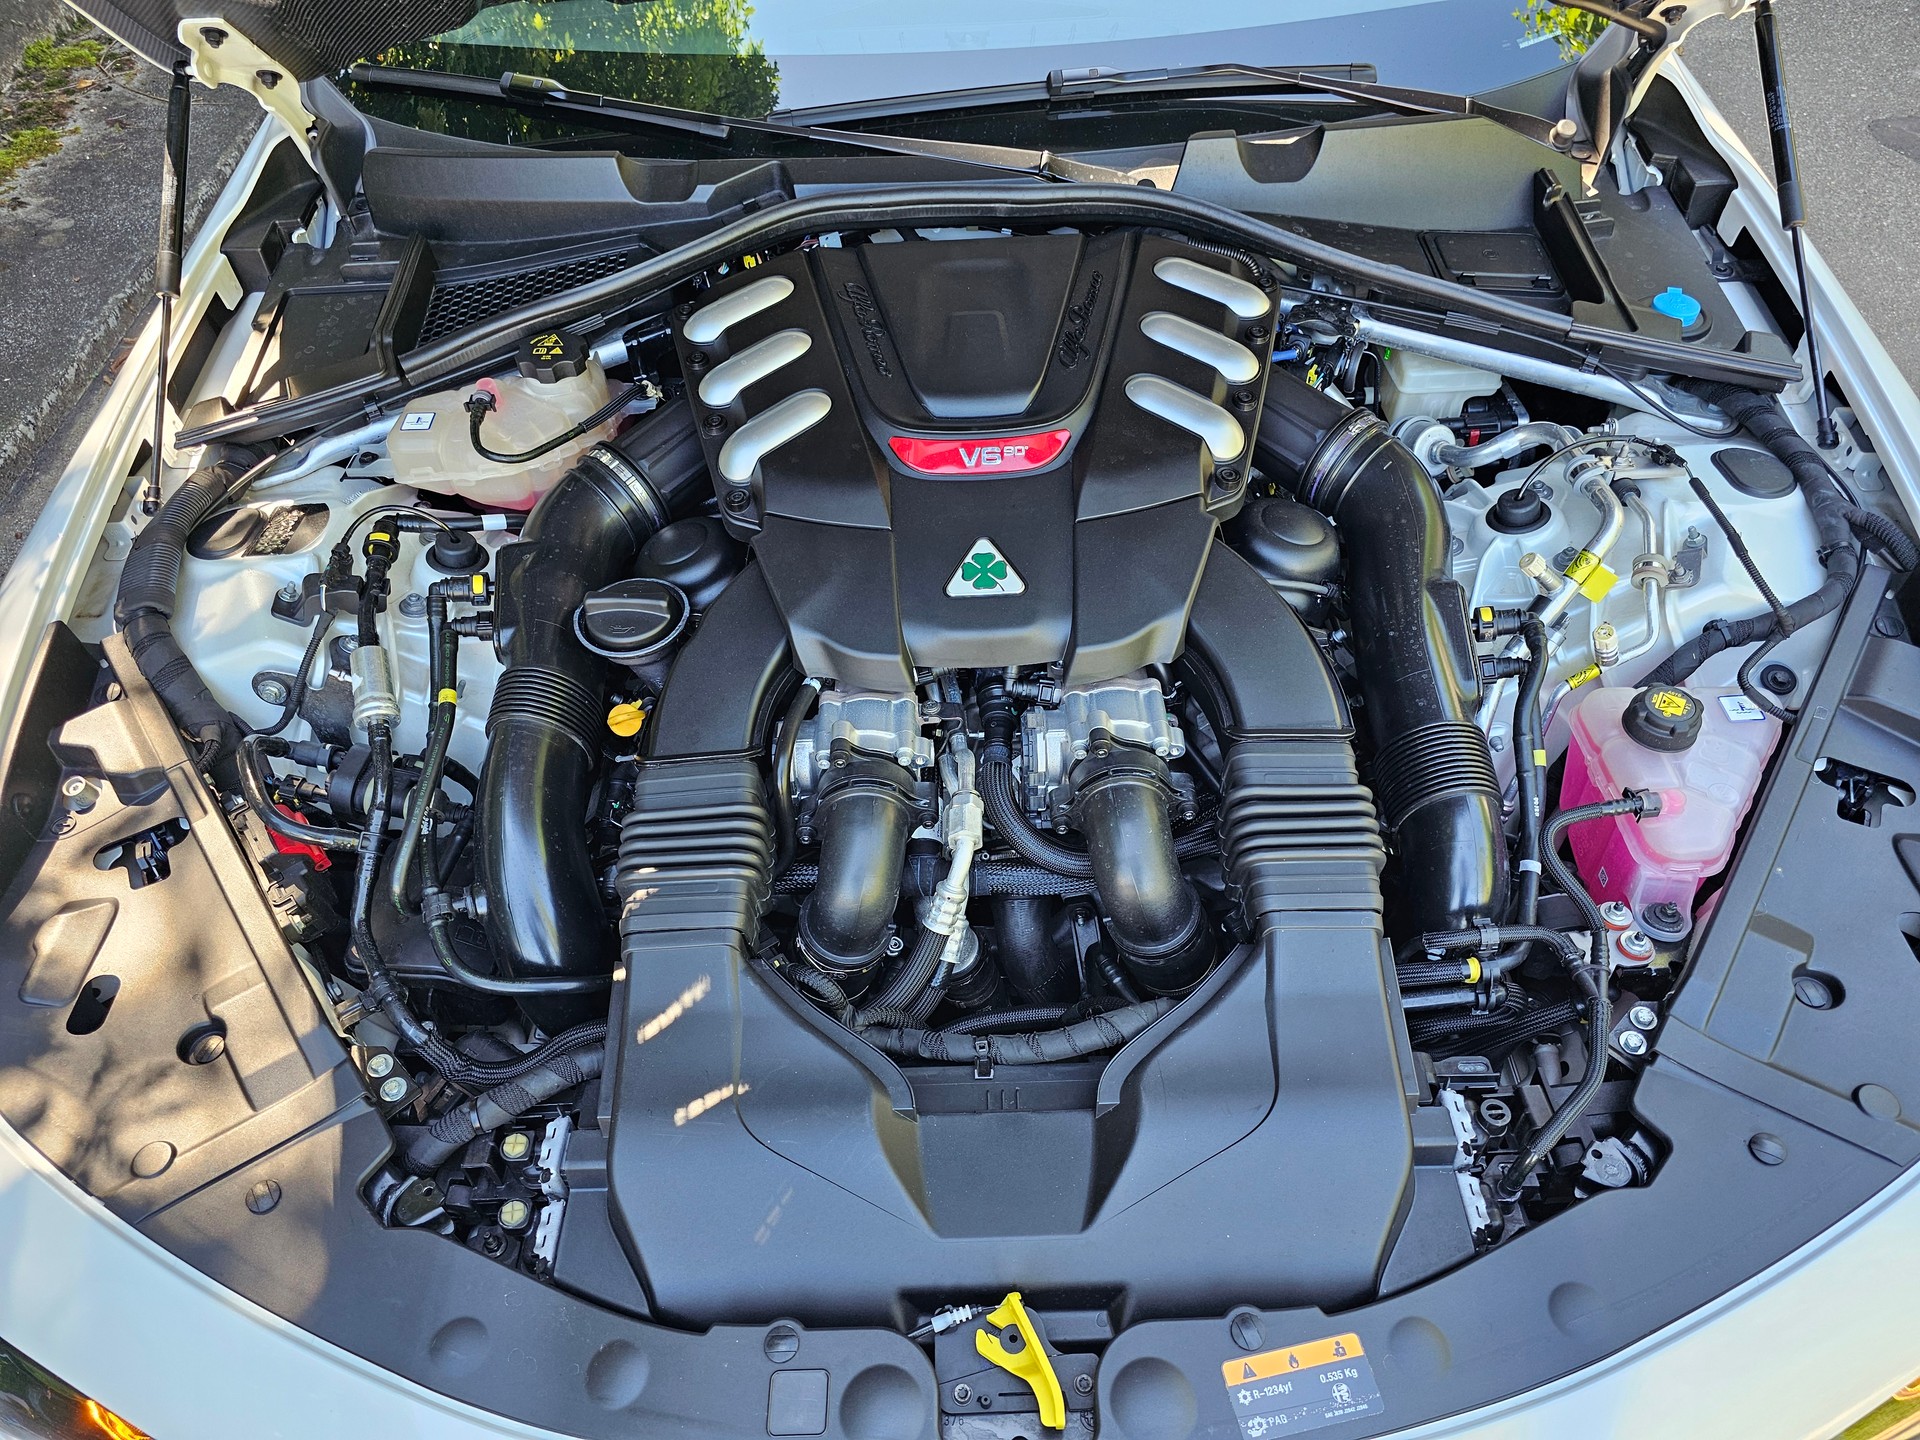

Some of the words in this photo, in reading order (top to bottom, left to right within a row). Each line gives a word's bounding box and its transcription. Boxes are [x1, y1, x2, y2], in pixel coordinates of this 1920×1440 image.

[1069, 270, 1103, 327] Romeo
[838, 282, 875, 319] Alfa
[860, 319, 892, 378] Romeo
[1059, 326, 1091, 371] Alfa
[1252, 1382, 1293, 1399] R-1234yf
[1319, 1371, 1344, 1384] 0.535
[1345, 1367, 1359, 1379] Kg
